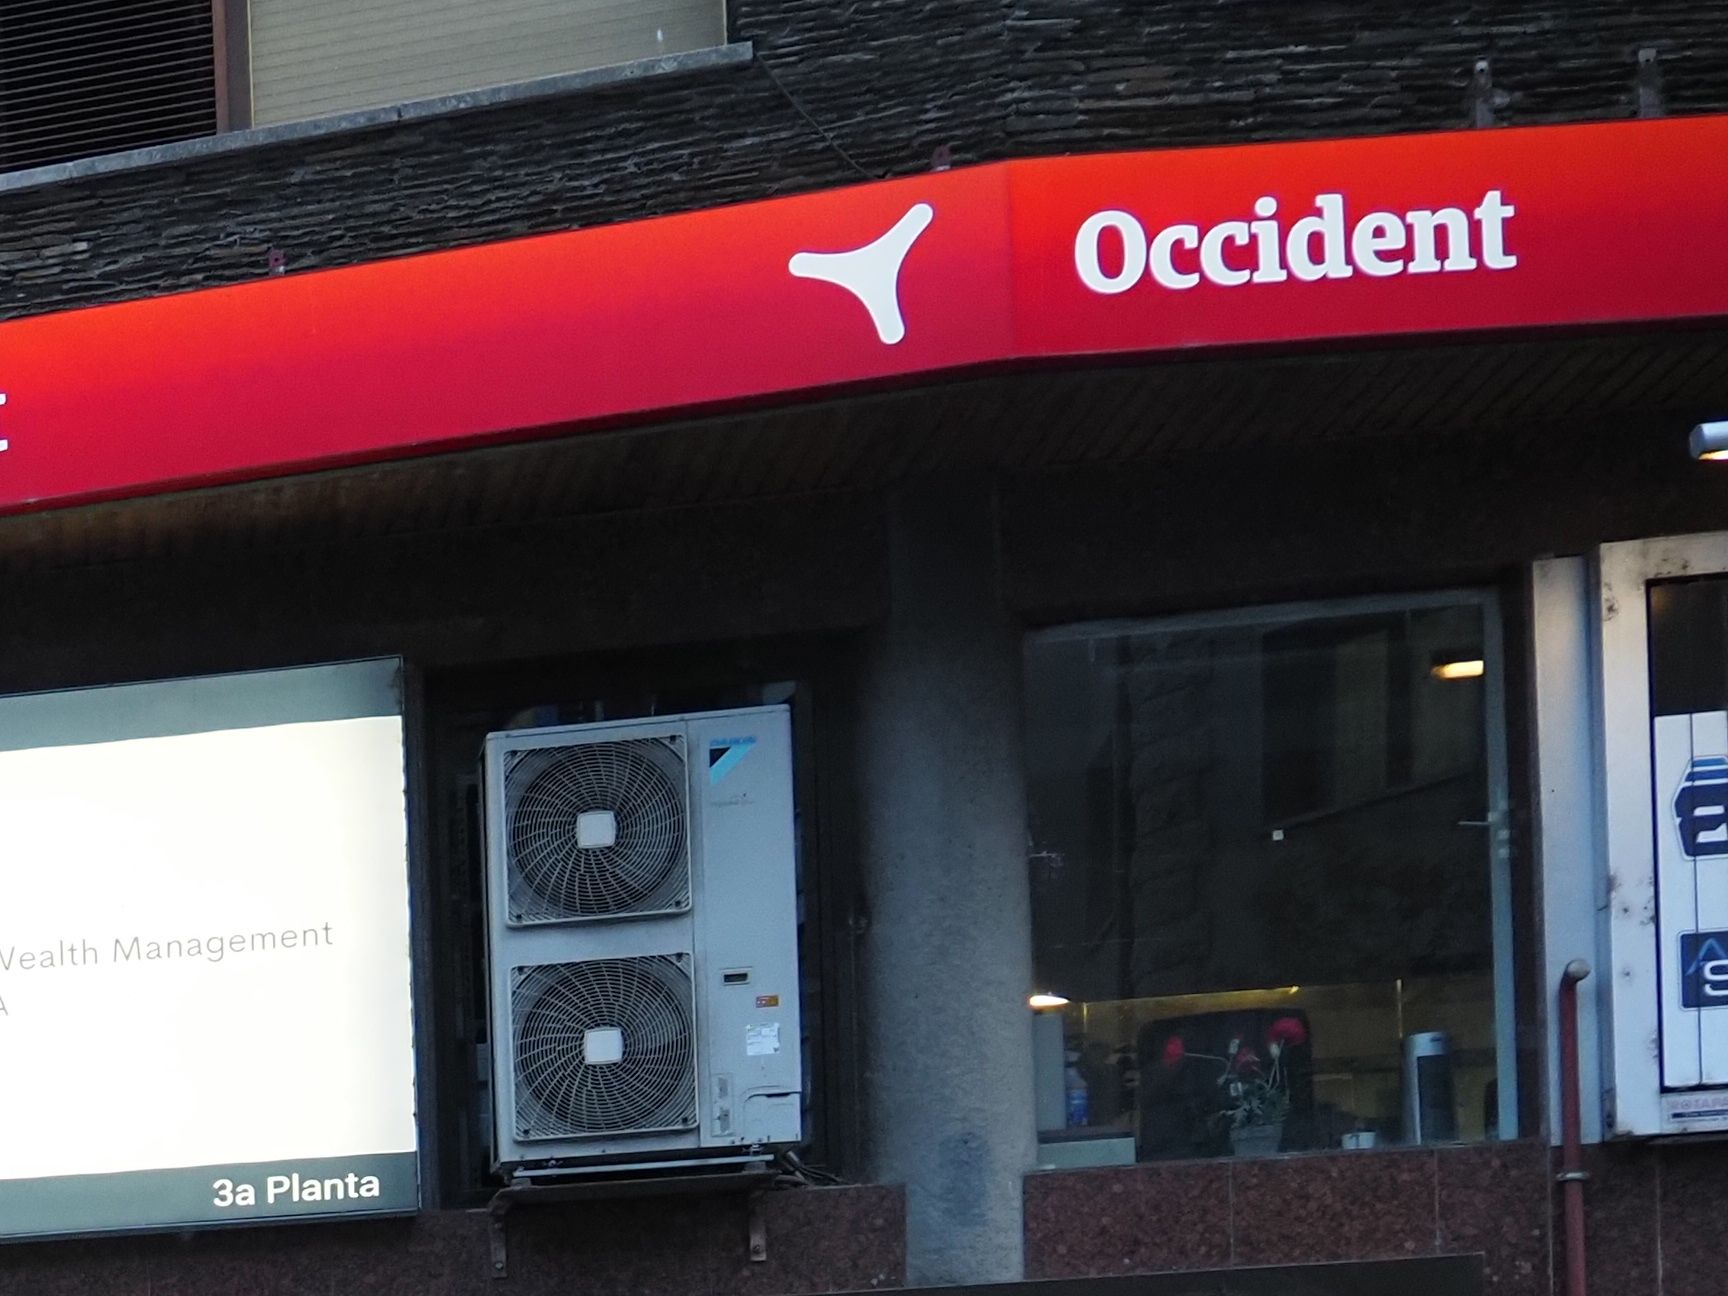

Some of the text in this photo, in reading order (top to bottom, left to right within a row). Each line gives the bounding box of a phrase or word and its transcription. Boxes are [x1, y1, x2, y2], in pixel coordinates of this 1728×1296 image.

[1074, 189, 1518, 295] Occident
[112, 920, 334, 963] Management
[211, 1171, 381, 1208] 3a Planta
